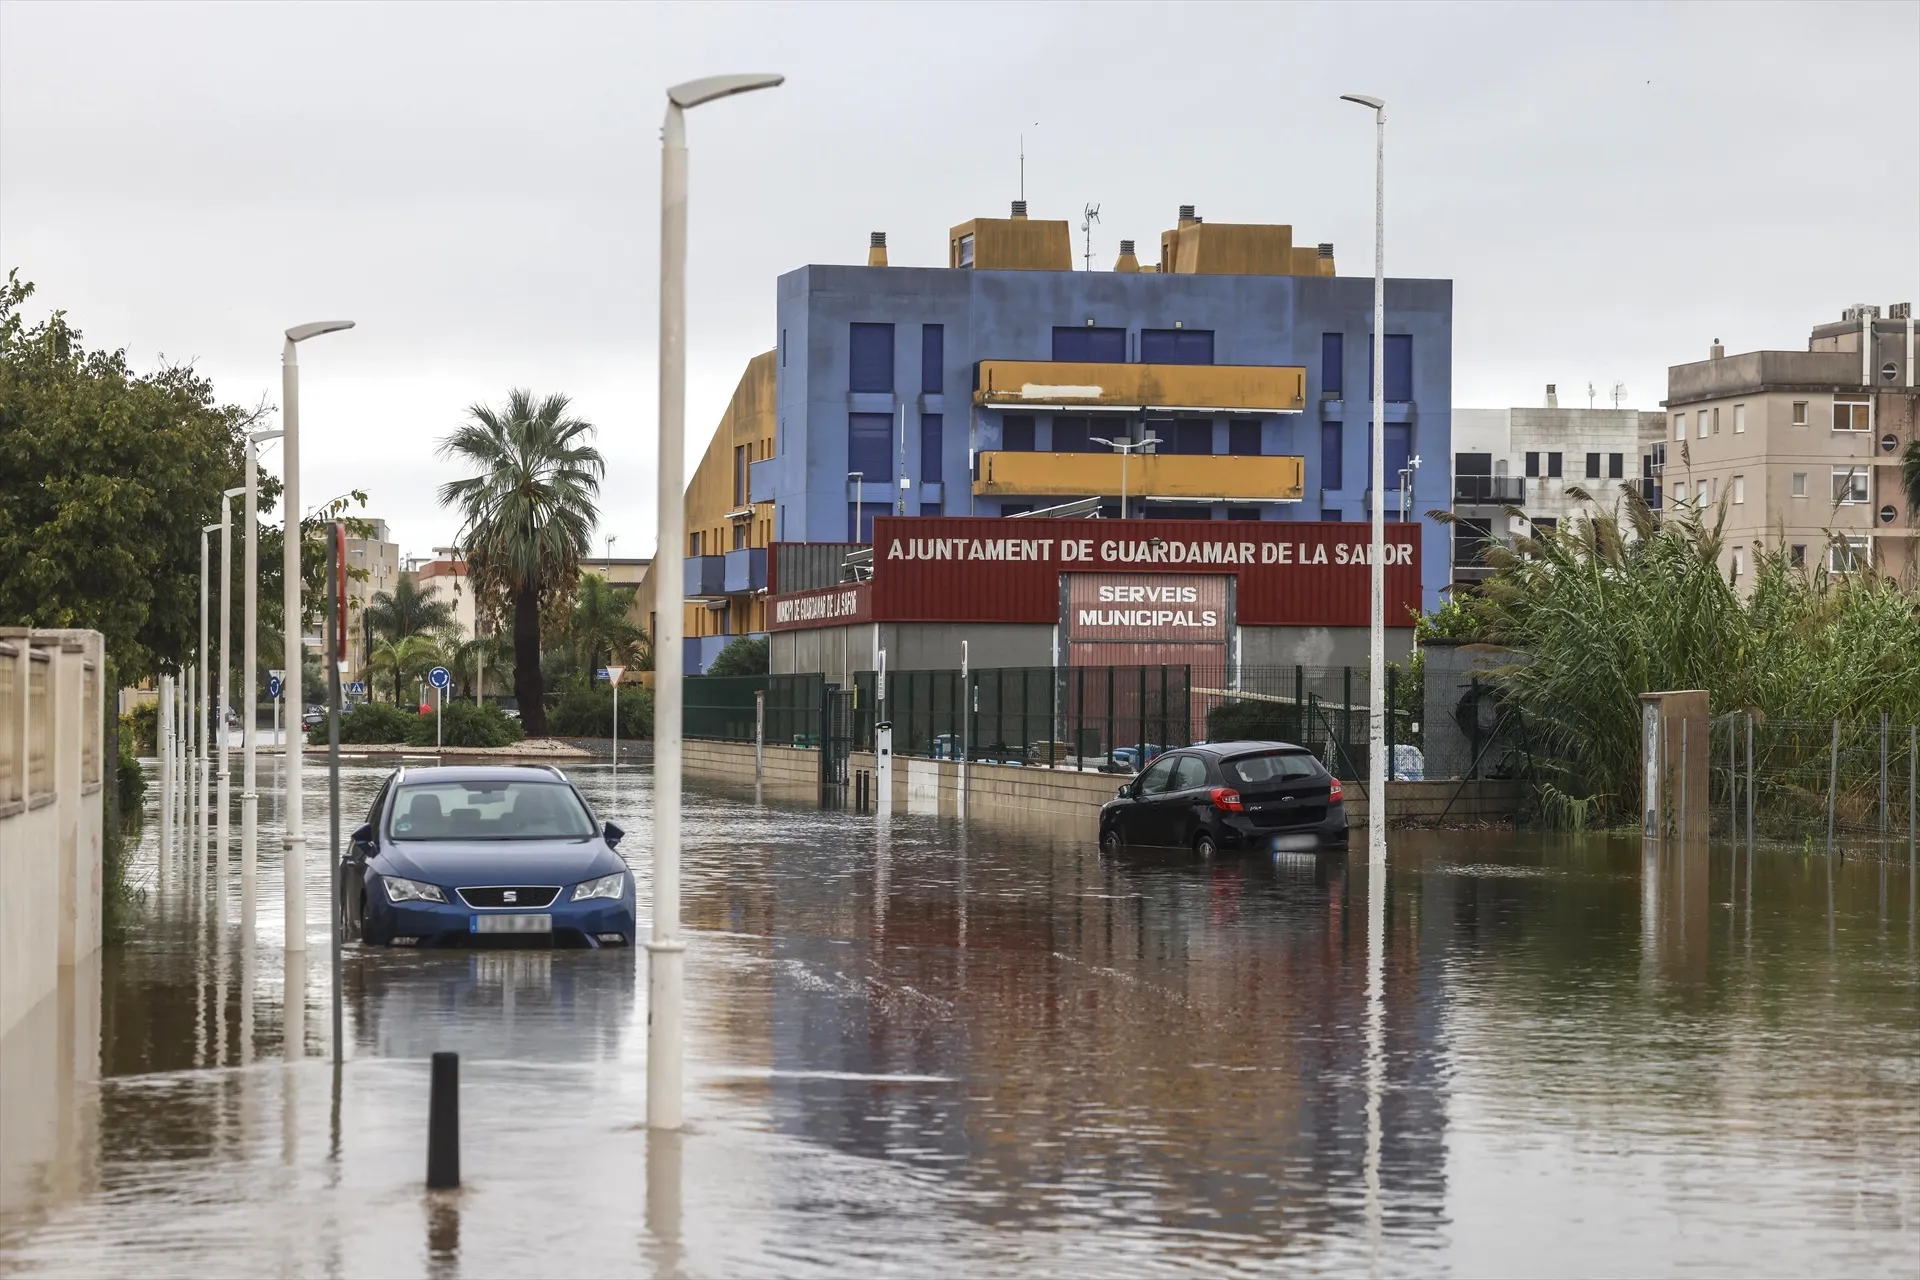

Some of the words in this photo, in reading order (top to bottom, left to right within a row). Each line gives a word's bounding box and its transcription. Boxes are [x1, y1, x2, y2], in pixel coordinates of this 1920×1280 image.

[887, 538, 1054, 561] AJUNTAMENT
[1061, 539, 1094, 562] DE
[1101, 539, 1256, 564] GUARDAMAR
[1261, 542, 1293, 564] DE
[1299, 543, 1329, 565] LA
[794, 599, 800, 620] DE
[801, 595, 826, 620] GUARDAMAR
[827, 594, 834, 618] DE
[834, 594, 840, 617] LA
[842, 590, 856, 615] SAFOR
[1099, 586, 1197, 603] SERVEIS
[1079, 609, 1217, 627] MUNICIPALS
